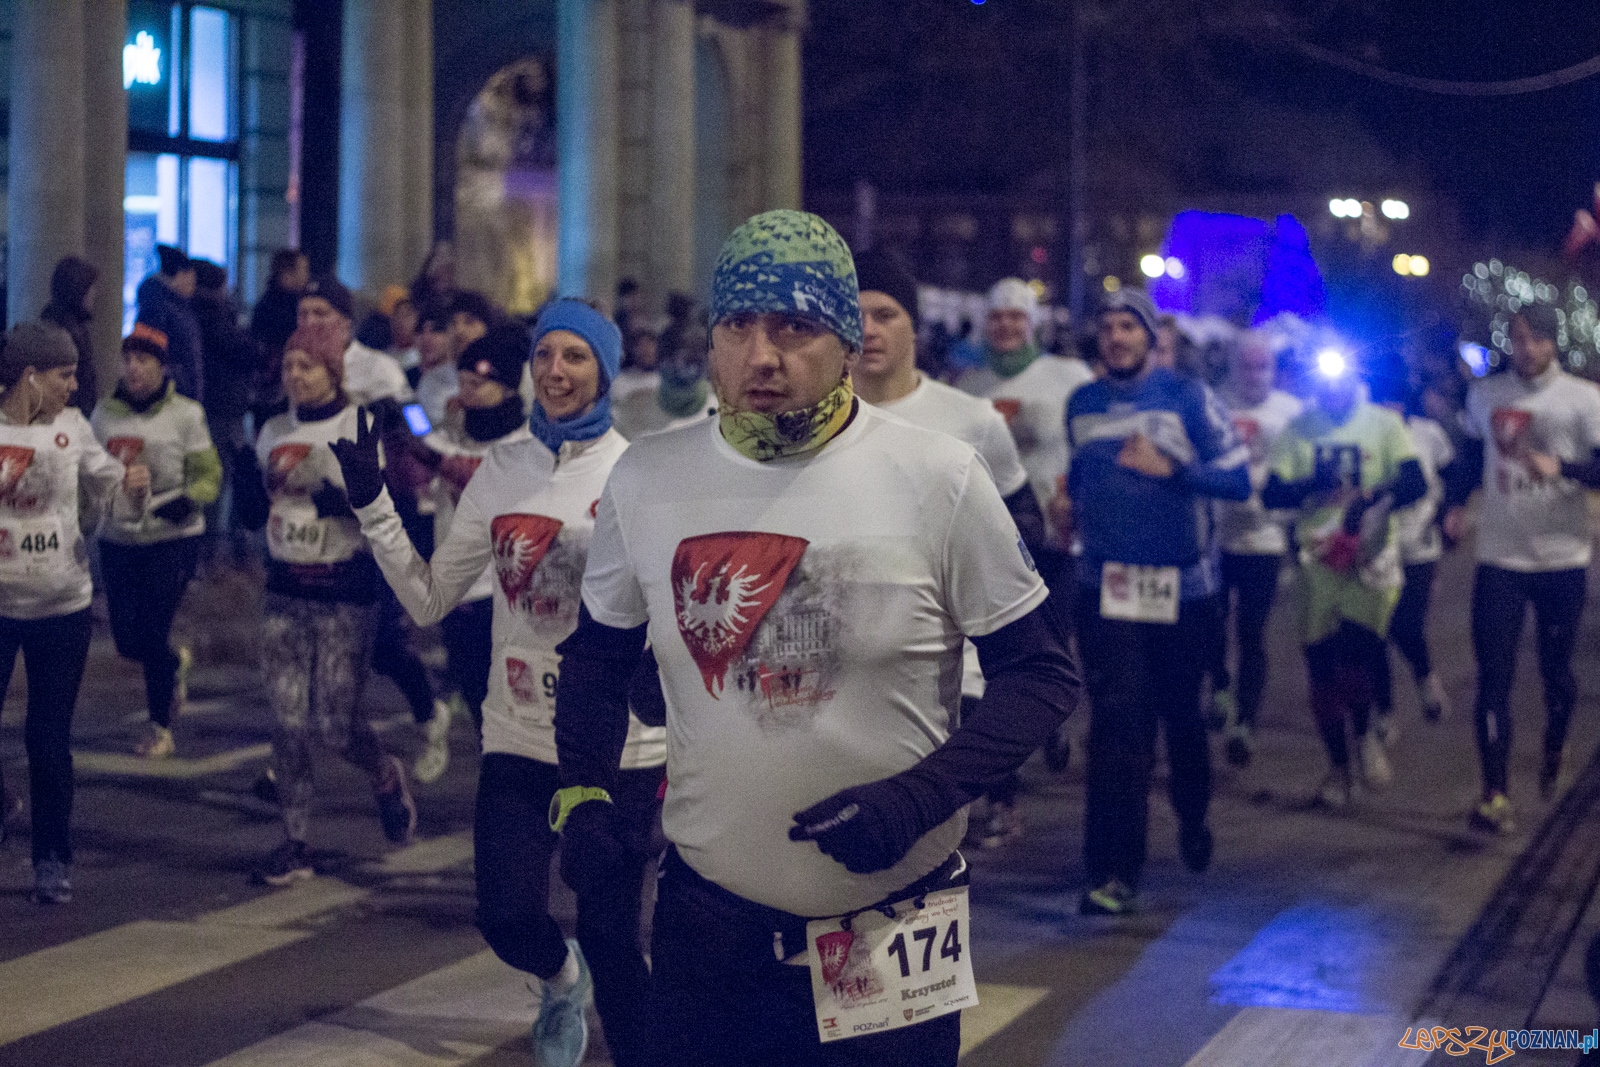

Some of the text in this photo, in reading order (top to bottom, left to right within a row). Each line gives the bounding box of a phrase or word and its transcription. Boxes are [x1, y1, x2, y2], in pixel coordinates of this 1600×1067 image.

[20, 531, 59, 553] 484
[887, 919, 962, 978] 174
[901, 974, 957, 1001] Krzysztof
